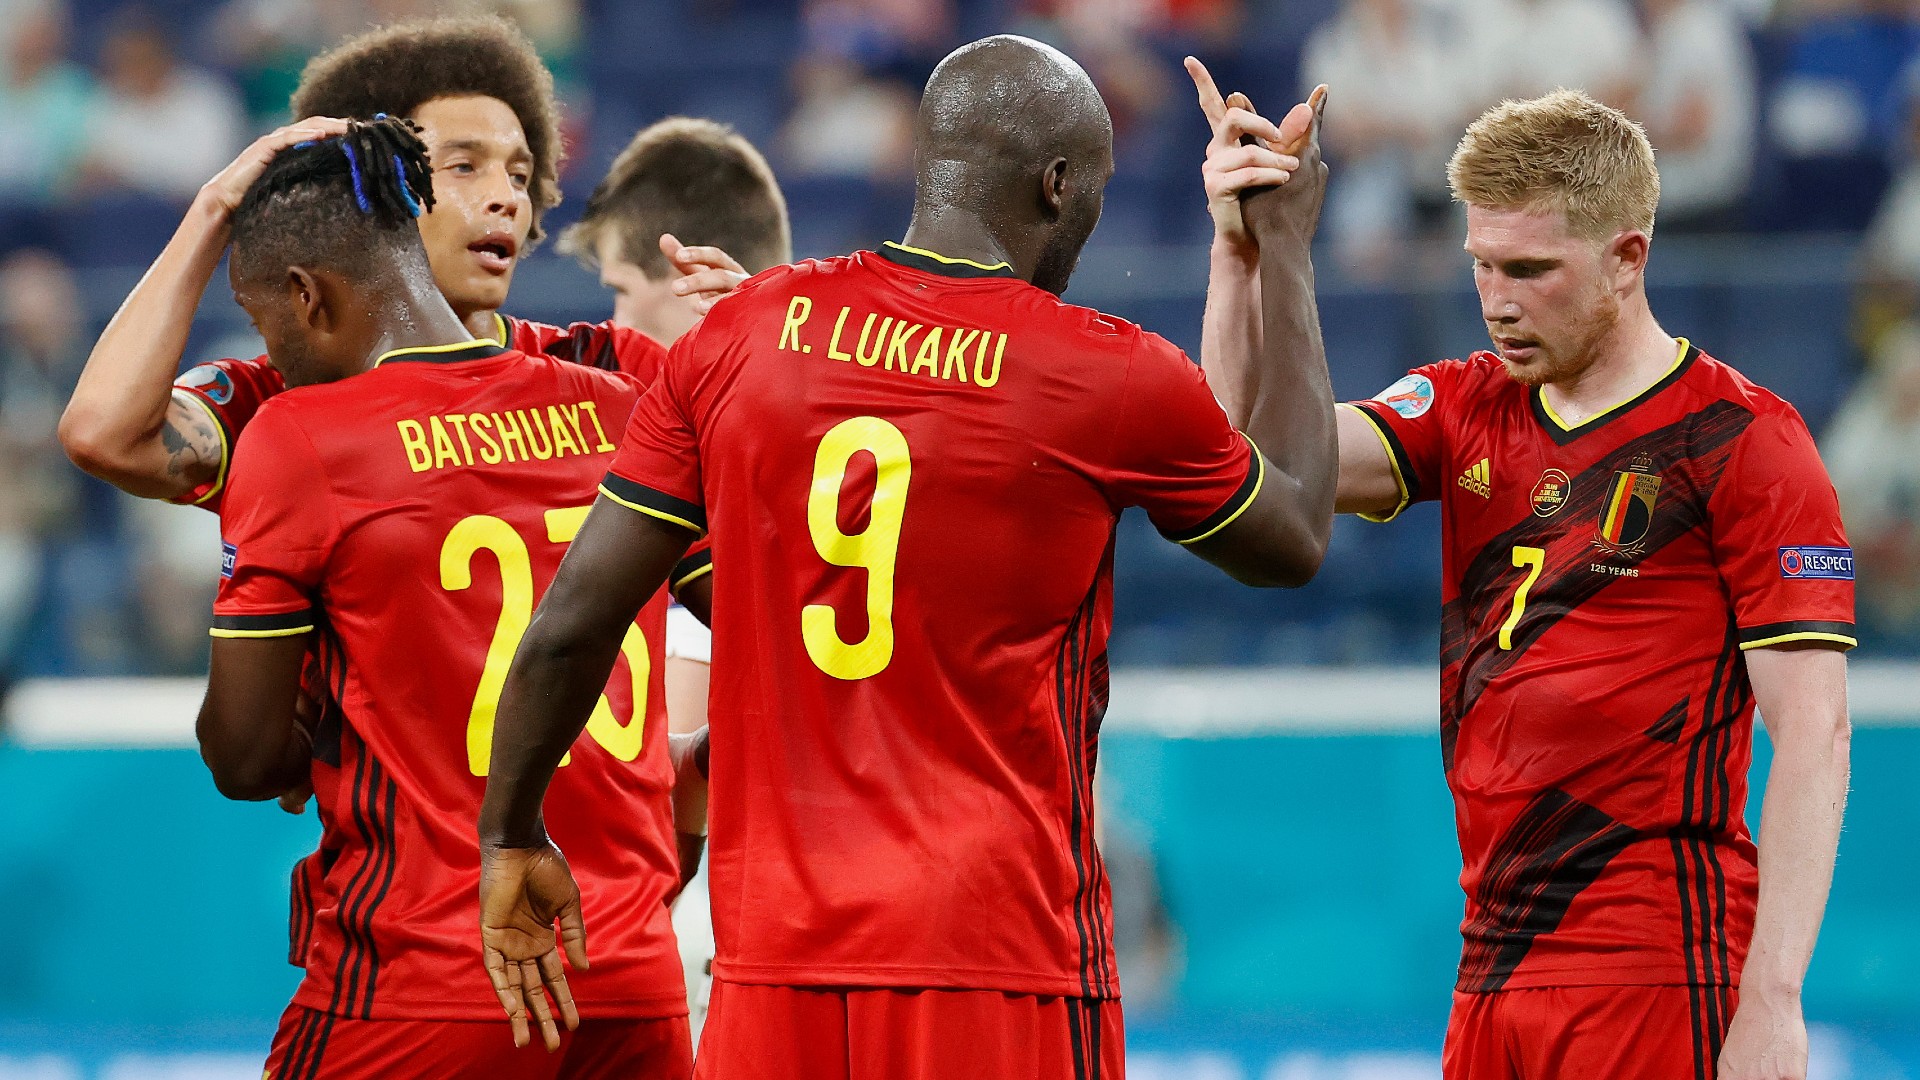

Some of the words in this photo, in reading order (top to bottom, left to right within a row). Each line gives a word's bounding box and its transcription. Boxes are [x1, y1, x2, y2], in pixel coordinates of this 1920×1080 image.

[778, 296, 812, 354] R.
[827, 306, 1008, 388] LUKAKU
[397, 401, 616, 473] BATSHUAYI
[1458, 476, 1491, 499] adidas
[801, 416, 911, 680] 9
[1590, 563, 1607, 573] 125
[1608, 566, 1639, 578] YEARS
[1804, 556, 1853, 571] RESPECT
[1499, 546, 1545, 650] 7
